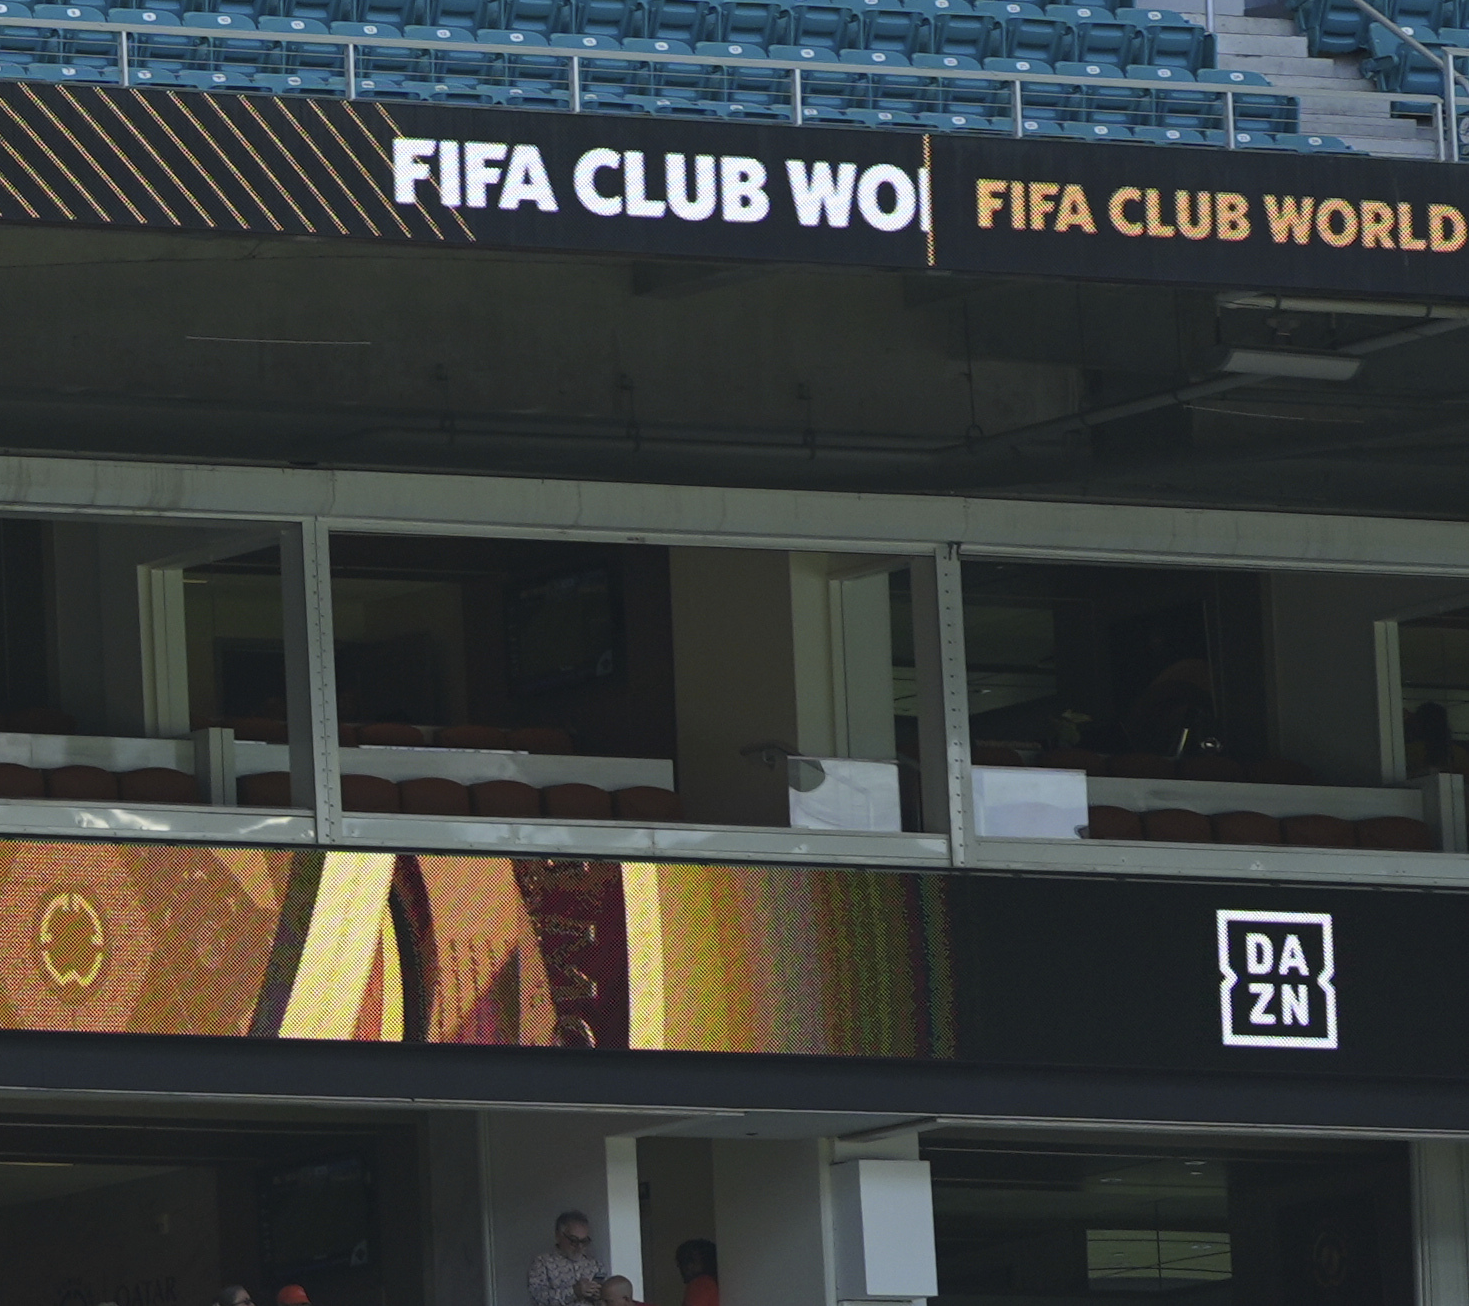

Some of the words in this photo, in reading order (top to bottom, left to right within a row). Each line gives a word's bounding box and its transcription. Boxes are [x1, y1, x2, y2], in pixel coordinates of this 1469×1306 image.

[392, 137, 558, 213] FIFA
[574, 148, 769, 222] CLUB
[977, 179, 1097, 233] FIFA
[1109, 187, 1250, 241] CLUB
[1264, 195, 1467, 252] WORLD
